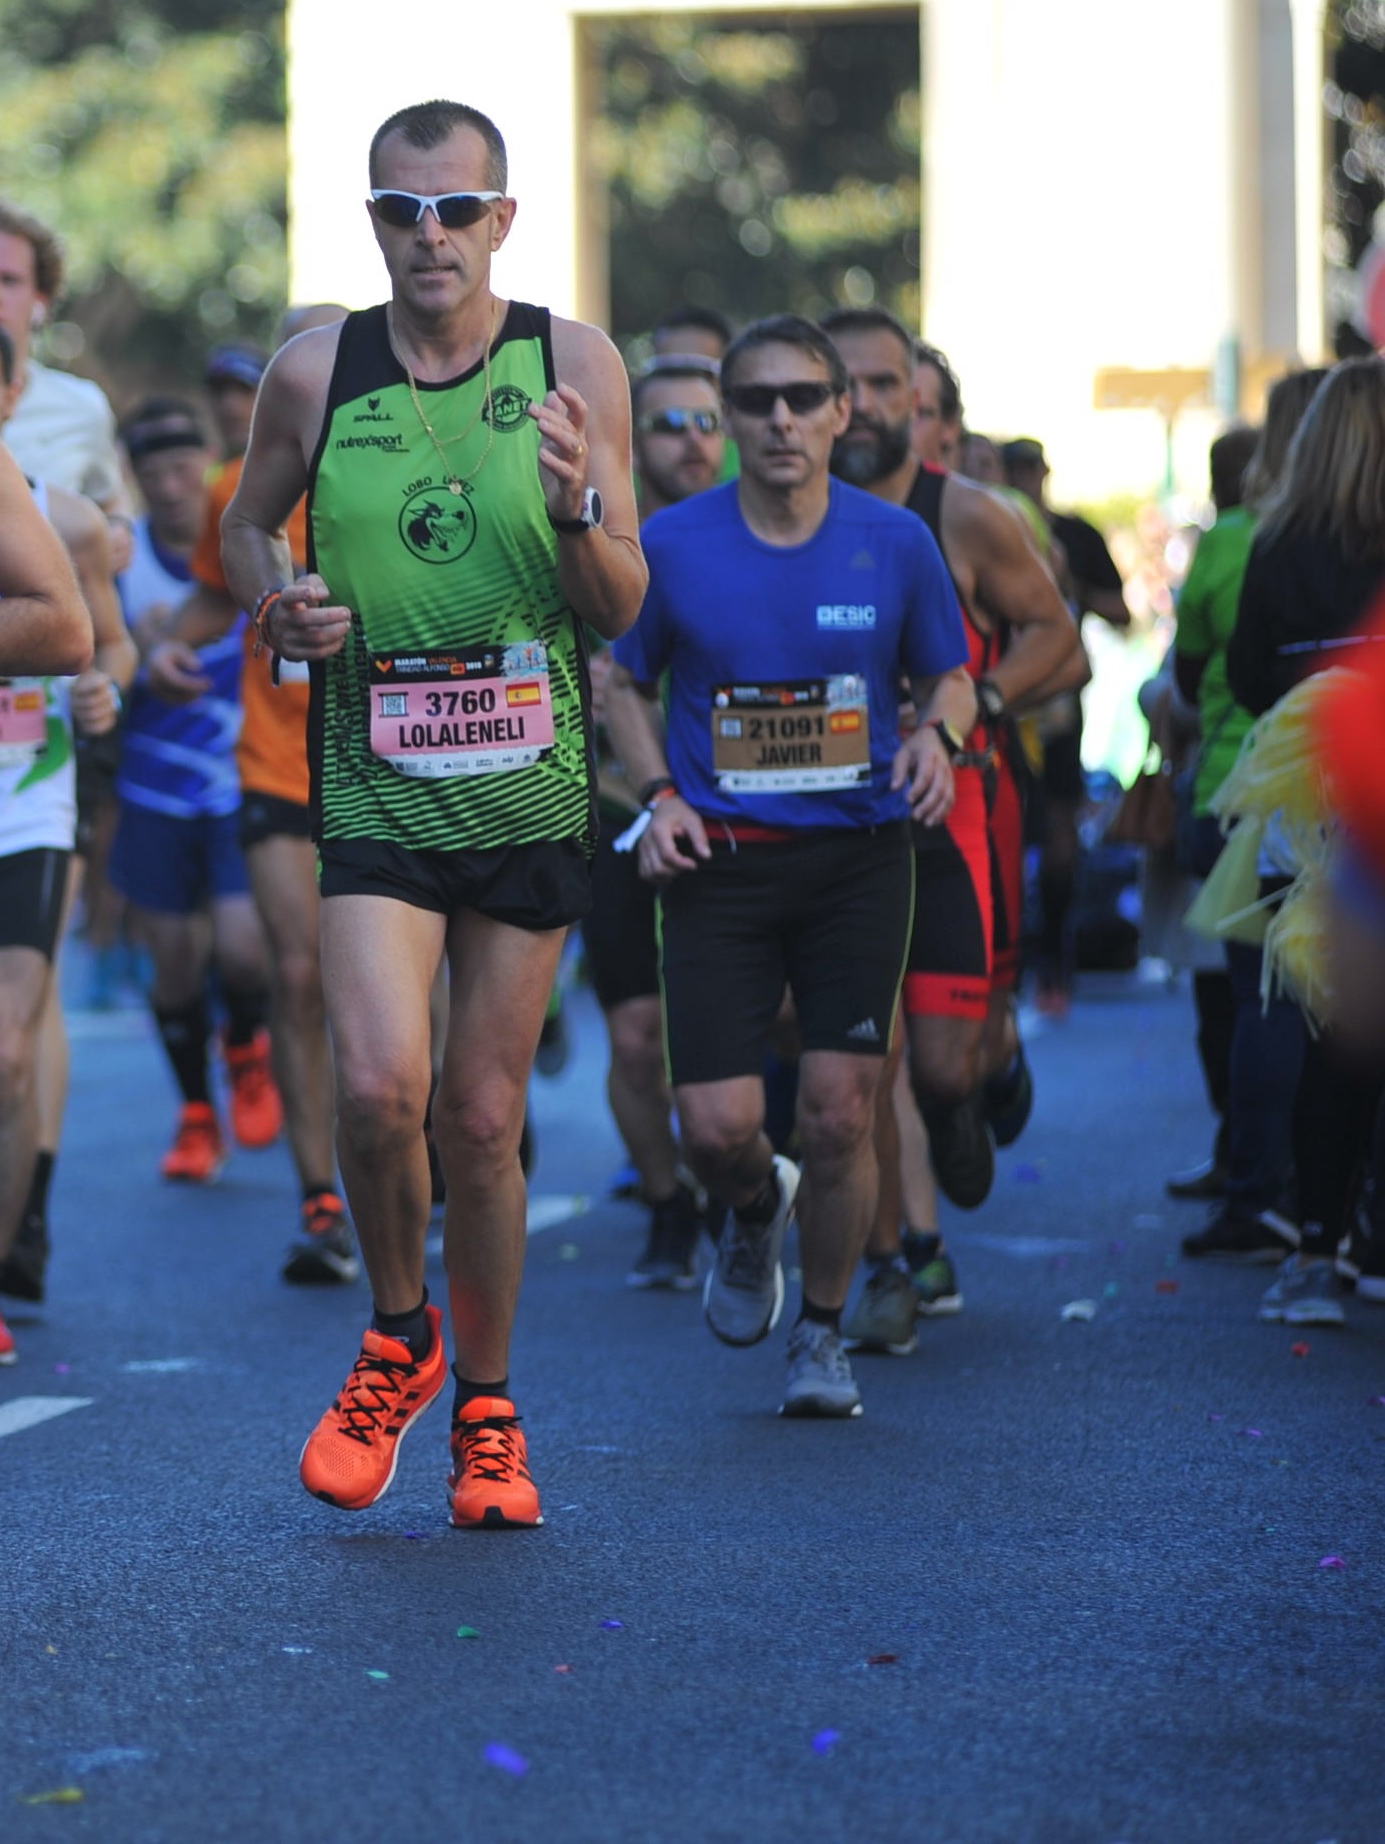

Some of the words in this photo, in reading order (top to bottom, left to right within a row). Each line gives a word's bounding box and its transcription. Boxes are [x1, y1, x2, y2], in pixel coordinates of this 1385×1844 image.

[402, 476, 432, 497] LOBO
[466, 661, 482, 670] 2018
[425, 688, 496, 717] 3760
[399, 716, 525, 748] LOLALENELI
[749, 714, 825, 741] 21091
[756, 742, 822, 766] JAVIER
